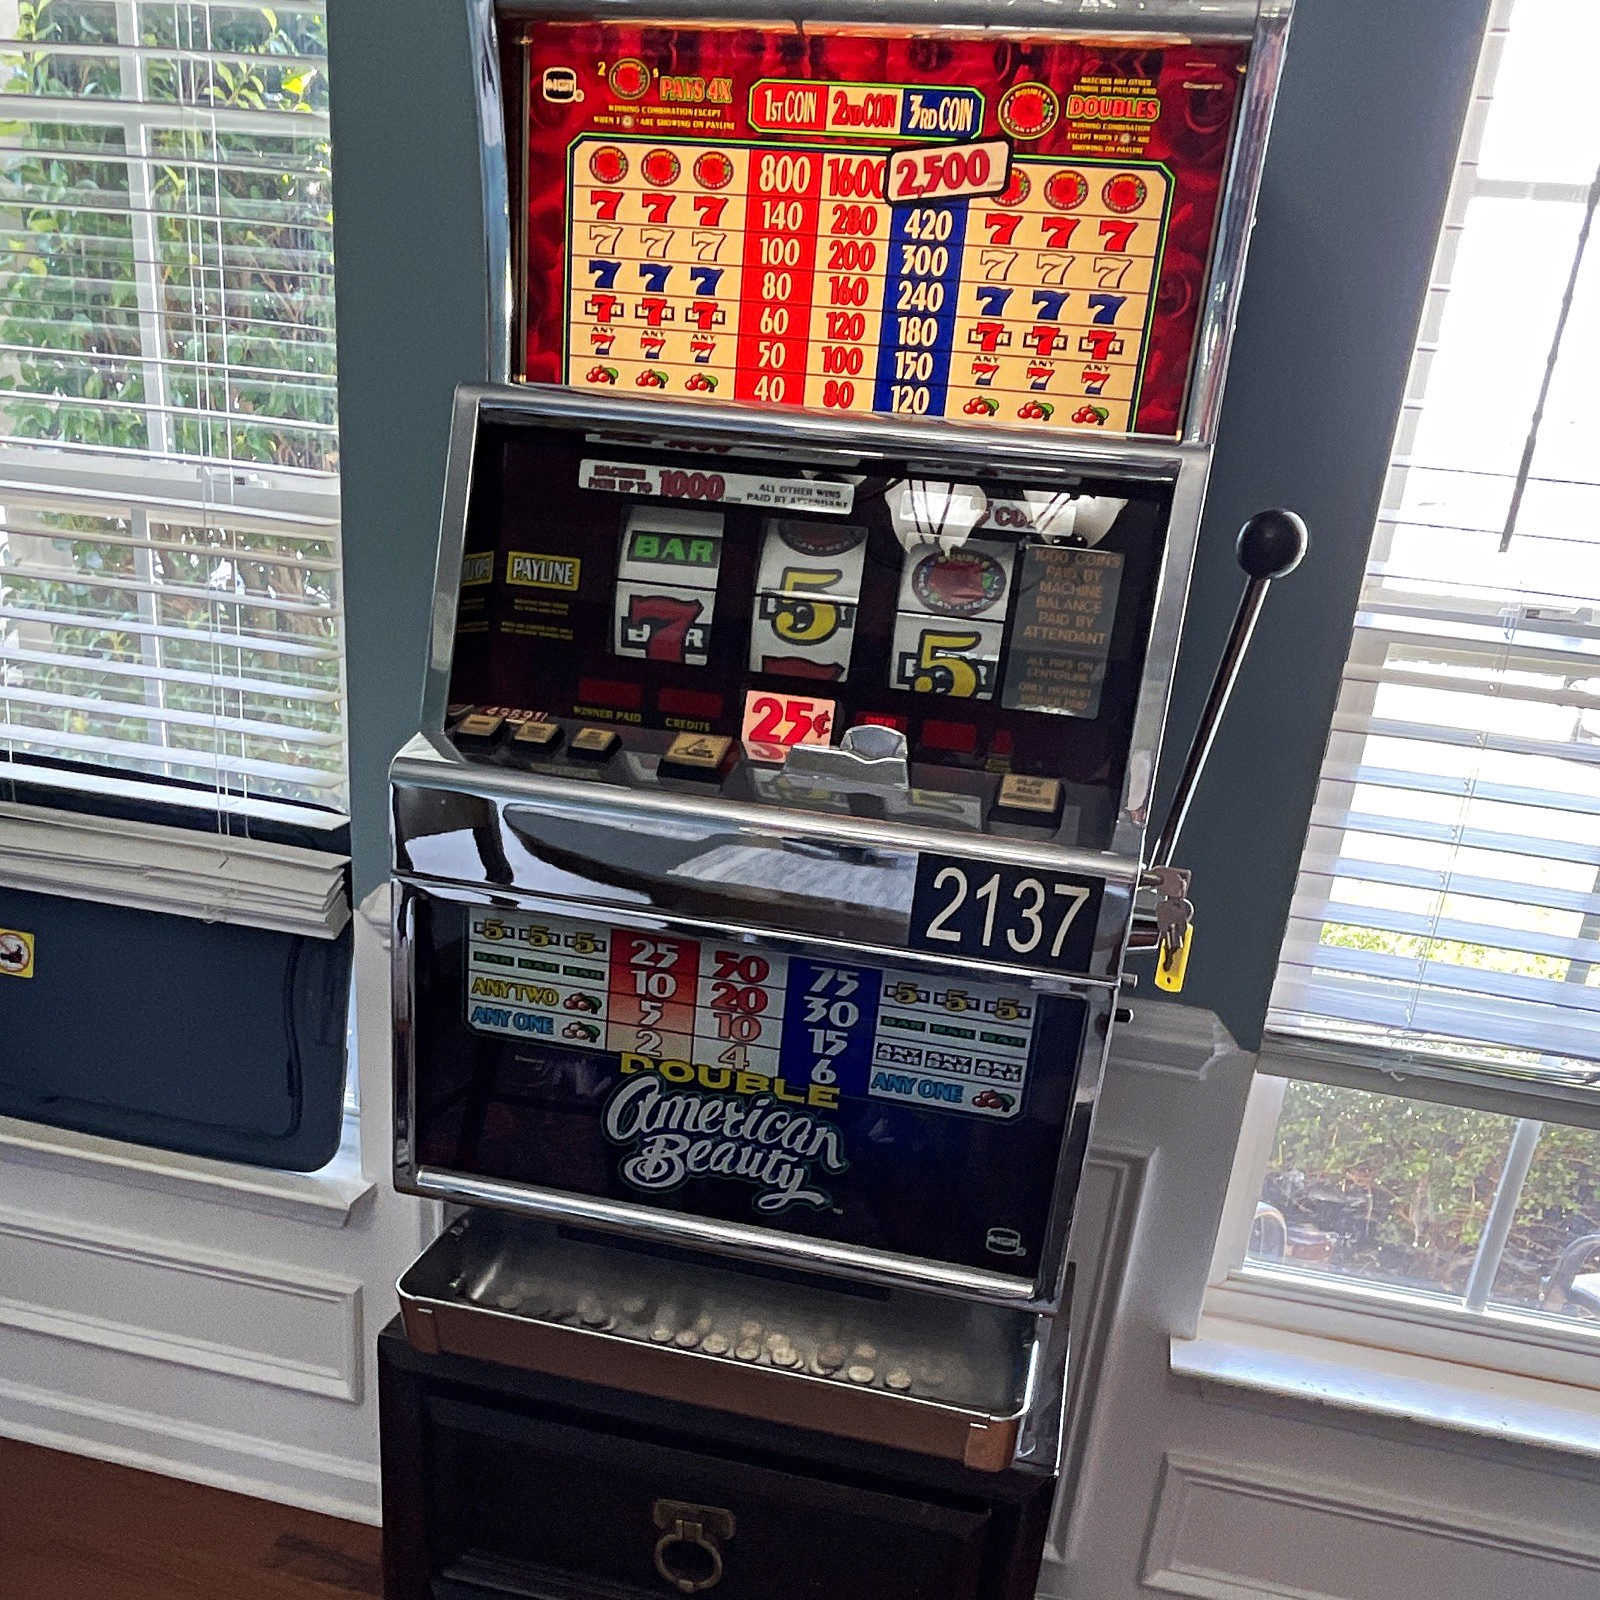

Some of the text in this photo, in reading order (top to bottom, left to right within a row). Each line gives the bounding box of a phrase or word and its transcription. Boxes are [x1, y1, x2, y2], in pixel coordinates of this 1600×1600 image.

[660, 76, 734, 104] PAYS 4X
[1067, 95, 1159, 121] DOUBLES
[759, 148, 990, 199] 800 1600 2,500
[590, 190, 1138, 253] 7 7 7 140 280 420 7 7 7
[589, 225, 1134, 289] 7 7 7 100 200 300 7 7 7
[588, 260, 1128, 325] 7 7 7 80 160 240 7 7 7
[759, 307, 789, 336] 60
[826, 311, 866, 341] 120
[897, 318, 939, 348] 180
[592, 326, 1110, 372] ANY ANY ANY ANY ANY ANY
[757, 341, 787, 369] 50
[821, 346, 864, 375] 100
[895, 351, 934, 381] 150
[753, 376, 930, 415] 40 80 120
[659, 468, 726, 501] 1000
[747, 492, 771, 502] PAID
[759, 484, 775, 493] ALL
[779, 485, 813, 496] OTHER
[634, 534, 714, 563] BAR
[1075, 553, 1120, 569] COINS
[513, 557, 574, 586] PAYLINE
[1040, 581, 1103, 599] MACHINE
[771, 566, 843, 646] 5
[1036, 595, 1102, 614] BALANCE
[1039, 610, 1096, 628] PAID BY
[1023, 625, 1106, 644] ATTENDANT
[573, 704, 643, 724] WINNER PAID
[665, 716, 711, 732] CREDITS
[926, 866, 1091, 958] 2137
[630, 939, 679, 969] 25
[712, 951, 770, 983] 50
[806, 966, 859, 996] 75
[472, 977, 512, 999] ANY
[511, 983, 559, 1006] TWO
[638, 1001, 663, 1027] 5
[714, 1013, 762, 1042] 10
[808, 1028, 848, 1057] 15
[631, 970, 677, 999] 10
[711, 982, 768, 1013] 20
[803, 996, 859, 1028] 30
[471, 1005, 964, 1103] ANY ONE 2 4 6 ANY ONE
[619, 1050, 840, 1111] DOUBLE
[606, 1076, 848, 1169] American
[623, 1134, 826, 1210] Beauty
